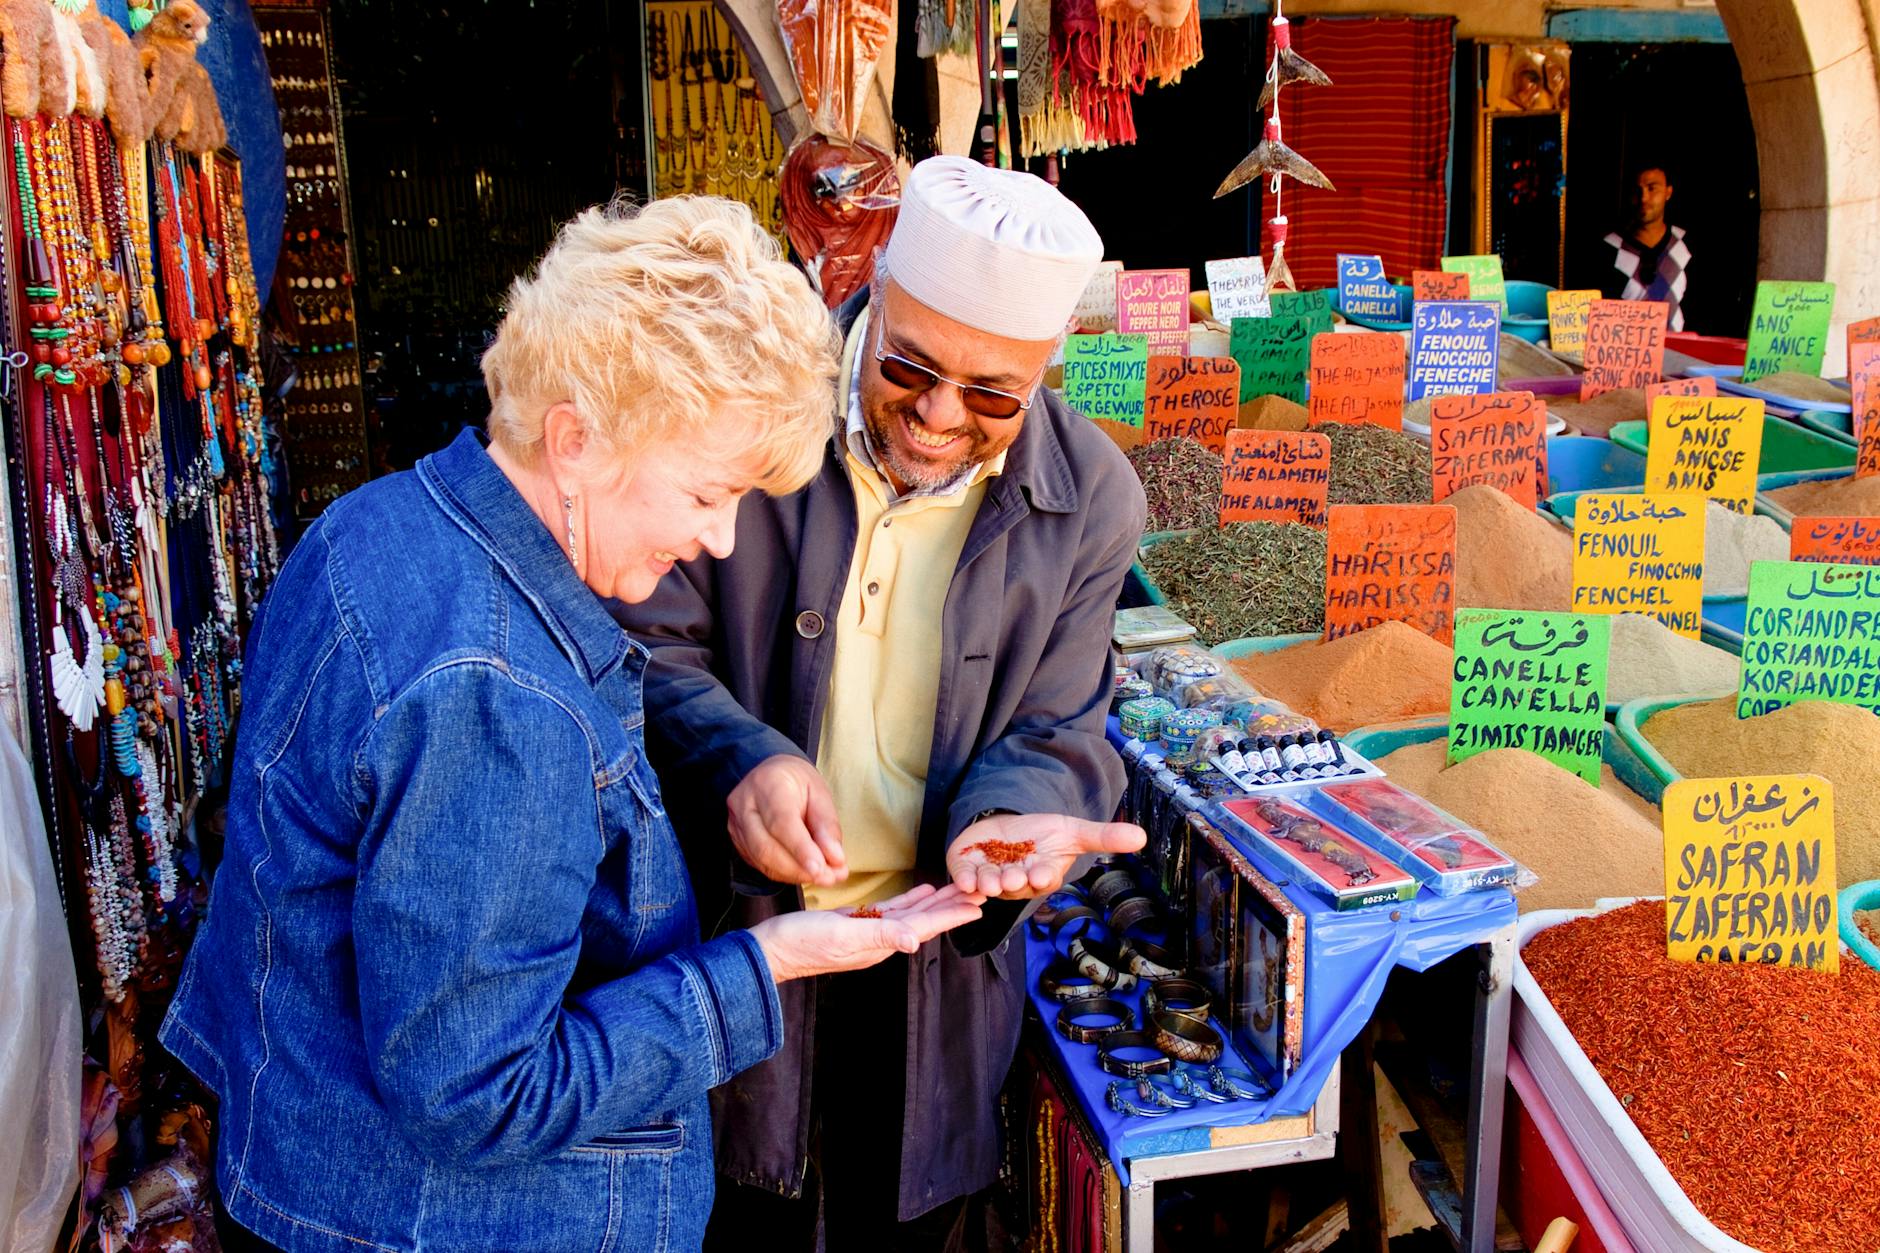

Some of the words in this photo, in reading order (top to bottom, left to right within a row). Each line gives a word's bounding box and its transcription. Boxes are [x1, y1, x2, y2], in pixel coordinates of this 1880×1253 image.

[1127, 301, 1159, 316] POIVRE
[1160, 301, 1181, 315] NOIR
[1345, 300, 1397, 315] CANELLA
[1129, 316, 1158, 330] PEPPER
[1159, 315, 1180, 329] NERO
[1755, 314, 1794, 335] ANIS
[1420, 334, 1488, 350] FENOUIL
[1590, 323, 1659, 347] CORETE
[1767, 336, 1817, 356] ANICE
[1415, 350, 1492, 366] FINOCCHIO
[1587, 345, 1652, 369] CORRETA
[1747, 357, 1782, 375] ANIS
[1413, 367, 1493, 383] FENECHE
[1679, 427, 1731, 448] ANIS
[1665, 470, 1718, 491] ANIS
[1641, 498, 1687, 524] حبة
[1578, 532, 1664, 558] FENOUIL
[1330, 550, 1455, 577] HARISSA
[1628, 561, 1703, 581] FINOCCHIO
[1574, 586, 1674, 605] FENCHEL
[1481, 617, 1589, 656] قرفة
[1454, 655, 1592, 687] CANELLE
[1461, 684, 1601, 716] CANELLA
[1677, 838, 1821, 891] SAFRAN
[1668, 891, 1832, 943] ZAFERANO
